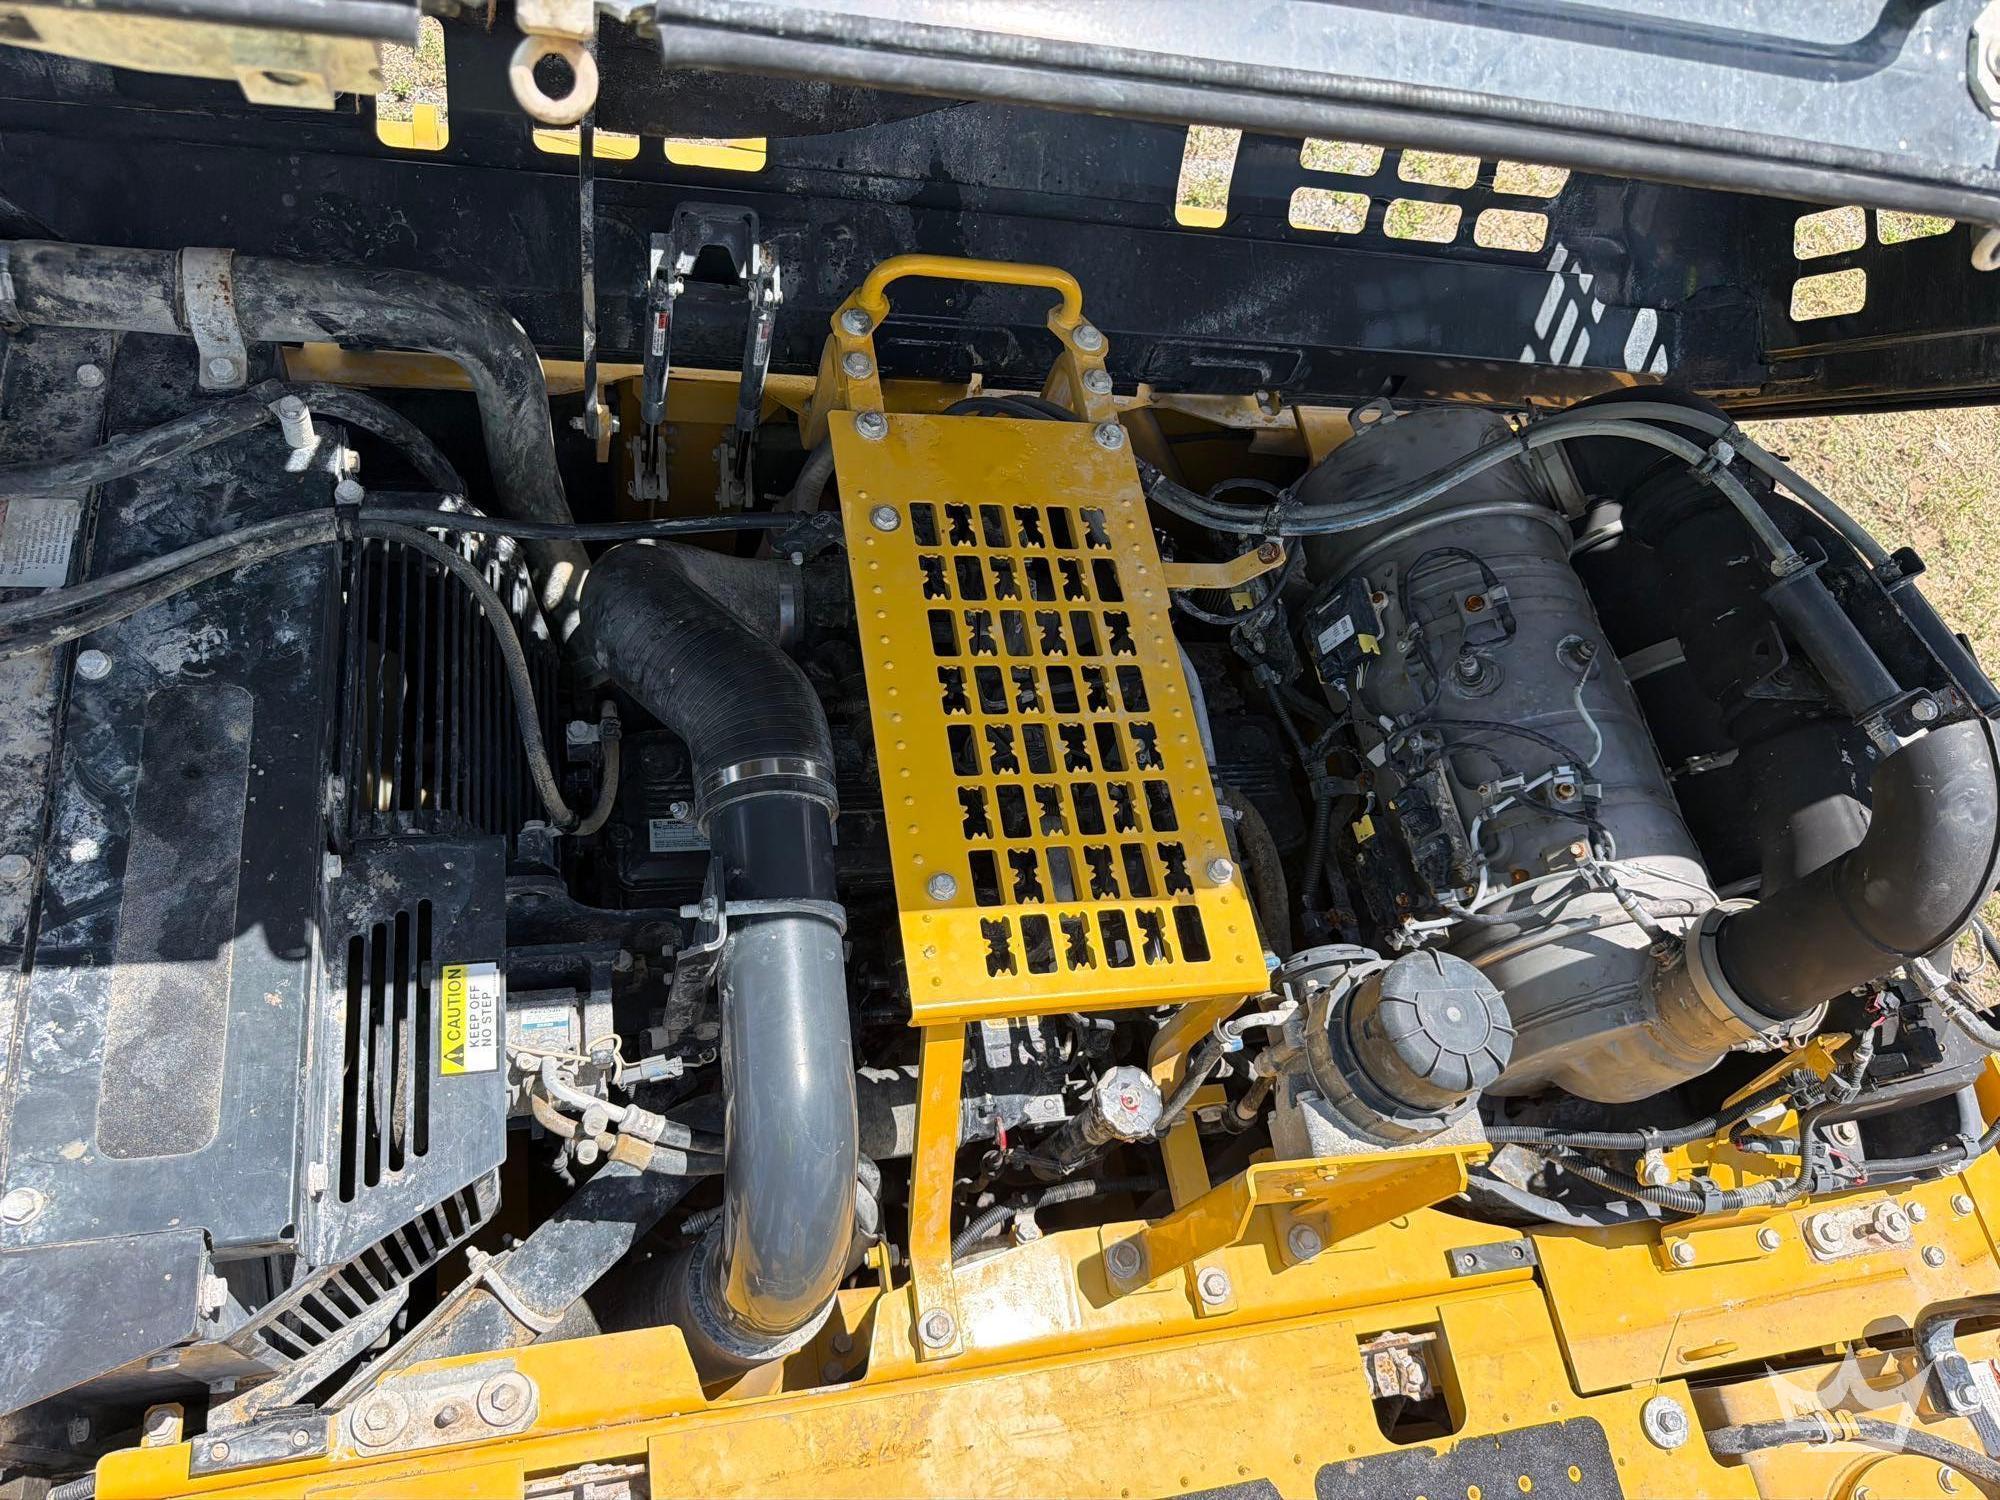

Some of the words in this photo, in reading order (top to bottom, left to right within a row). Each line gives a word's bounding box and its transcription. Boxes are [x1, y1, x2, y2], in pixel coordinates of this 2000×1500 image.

[446, 967, 462, 1042] CAUTION
[469, 985, 480, 1010] OFF
[482, 991, 492, 1024] STEP
[469, 1014, 480, 1048] KEEP
[481, 1028, 492, 1047] NO
